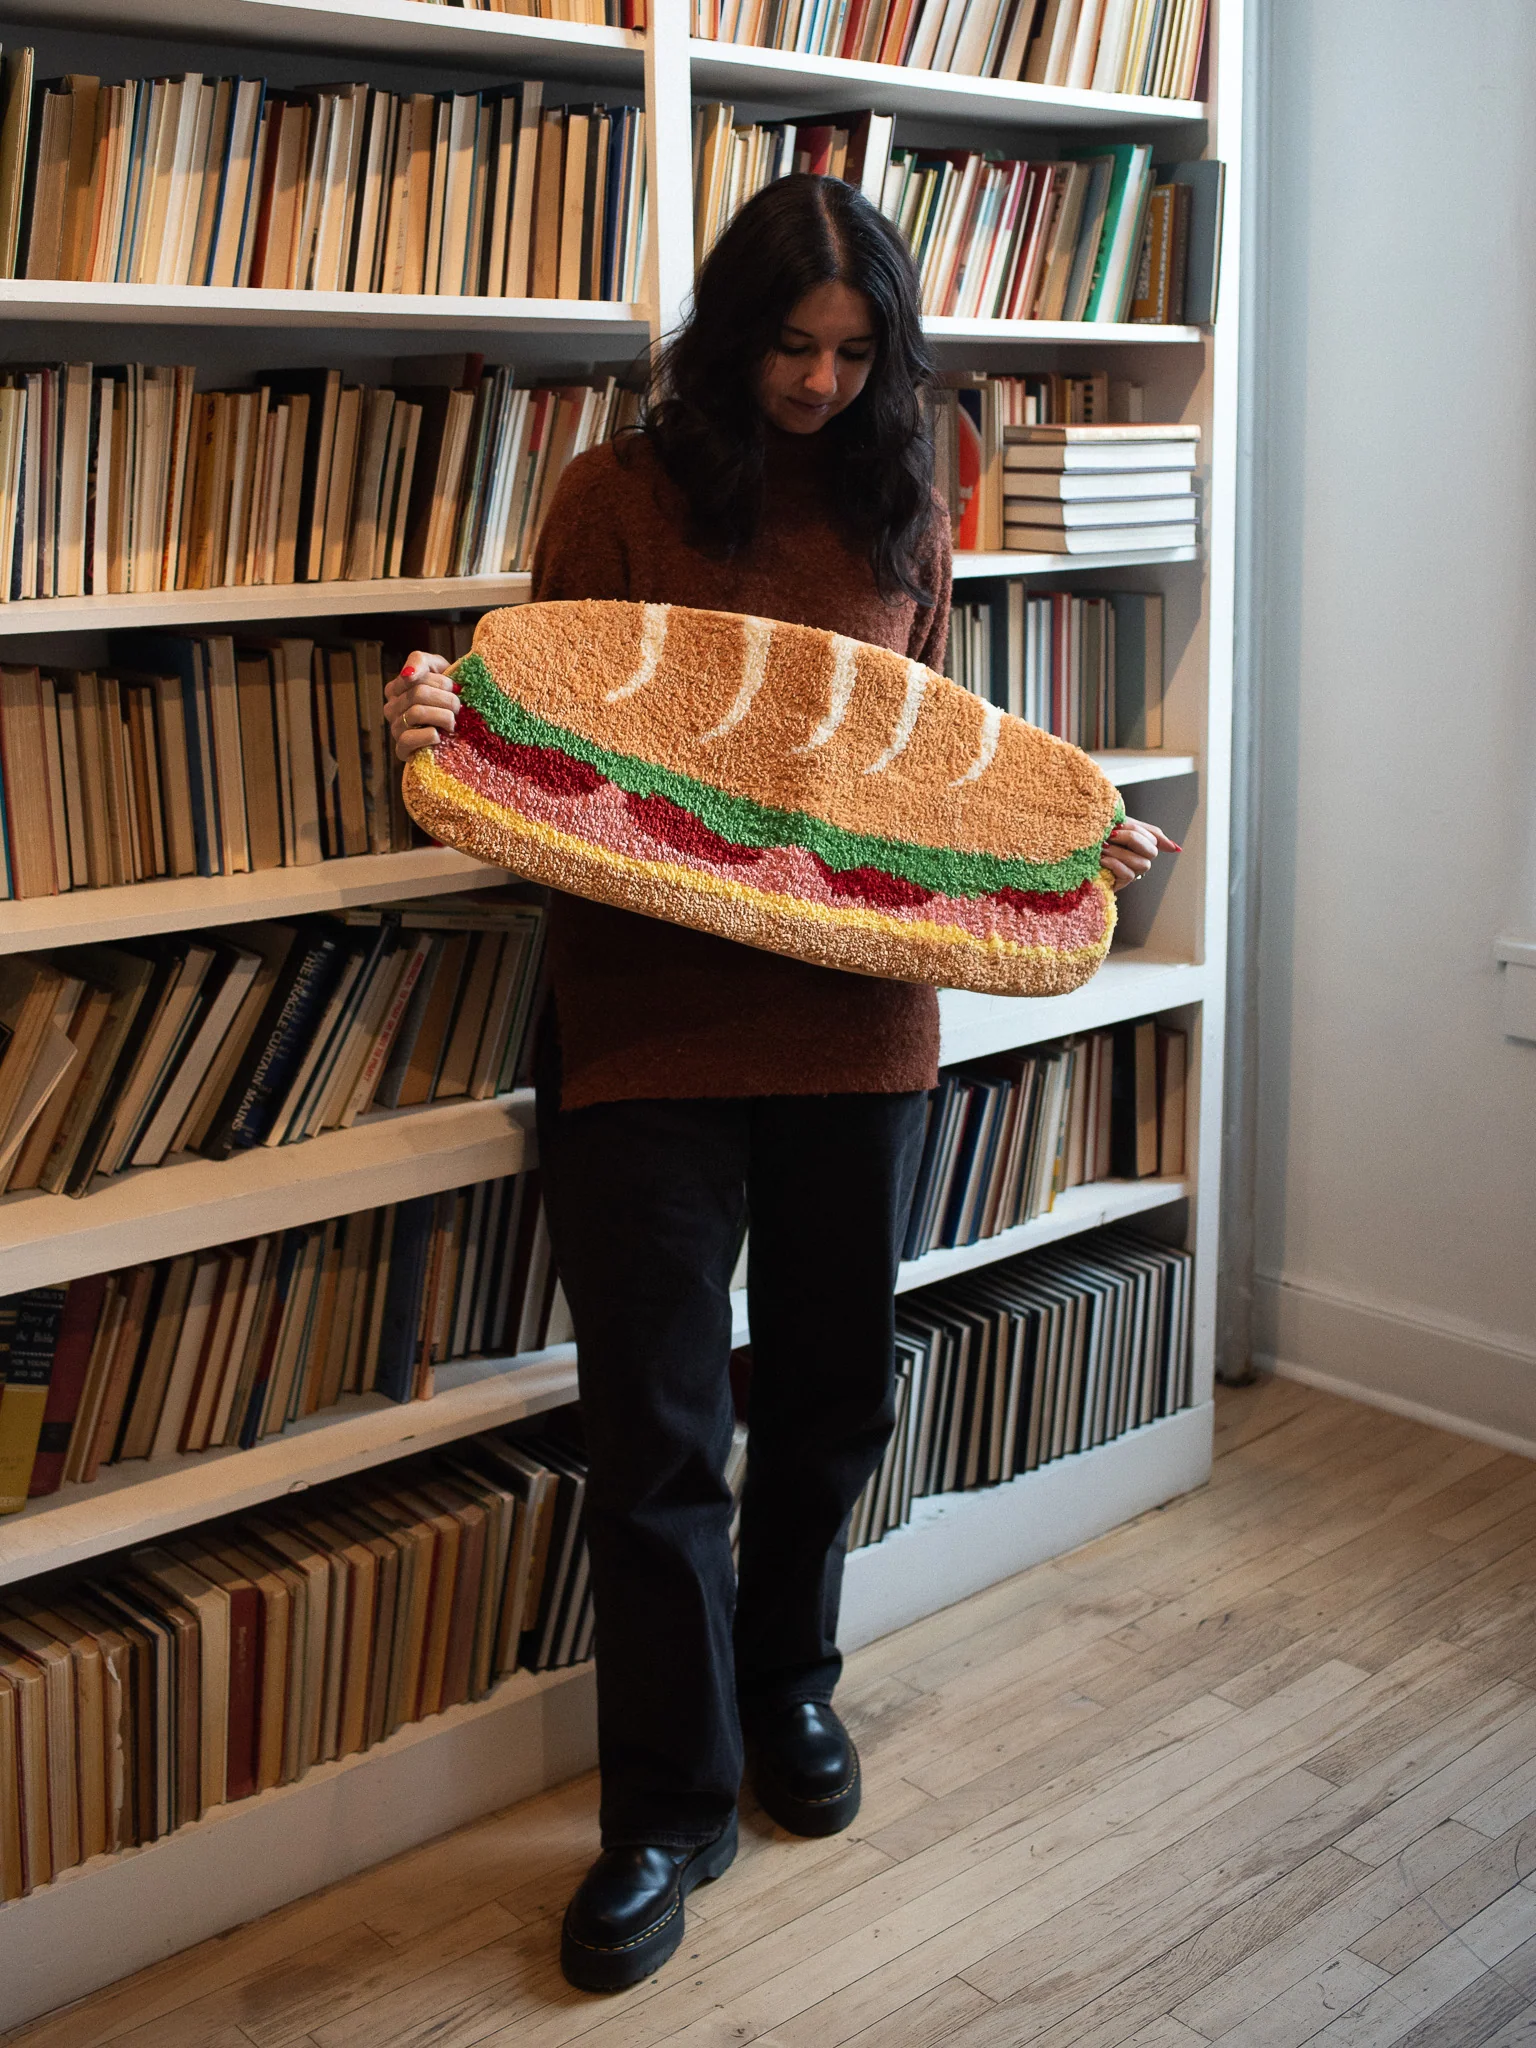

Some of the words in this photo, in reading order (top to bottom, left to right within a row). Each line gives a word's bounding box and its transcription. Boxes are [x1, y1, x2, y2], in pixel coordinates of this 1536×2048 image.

[299, 949, 318, 976] THE
[275, 976, 306, 1029] FRAGILE
[250, 1028, 284, 1086] CURTAIN
[230, 1087, 257, 1132] MAINS
[21, 1312, 42, 1325] Story
[46, 1313, 56, 1328] of
[33, 1331, 54, 1343] Bible
